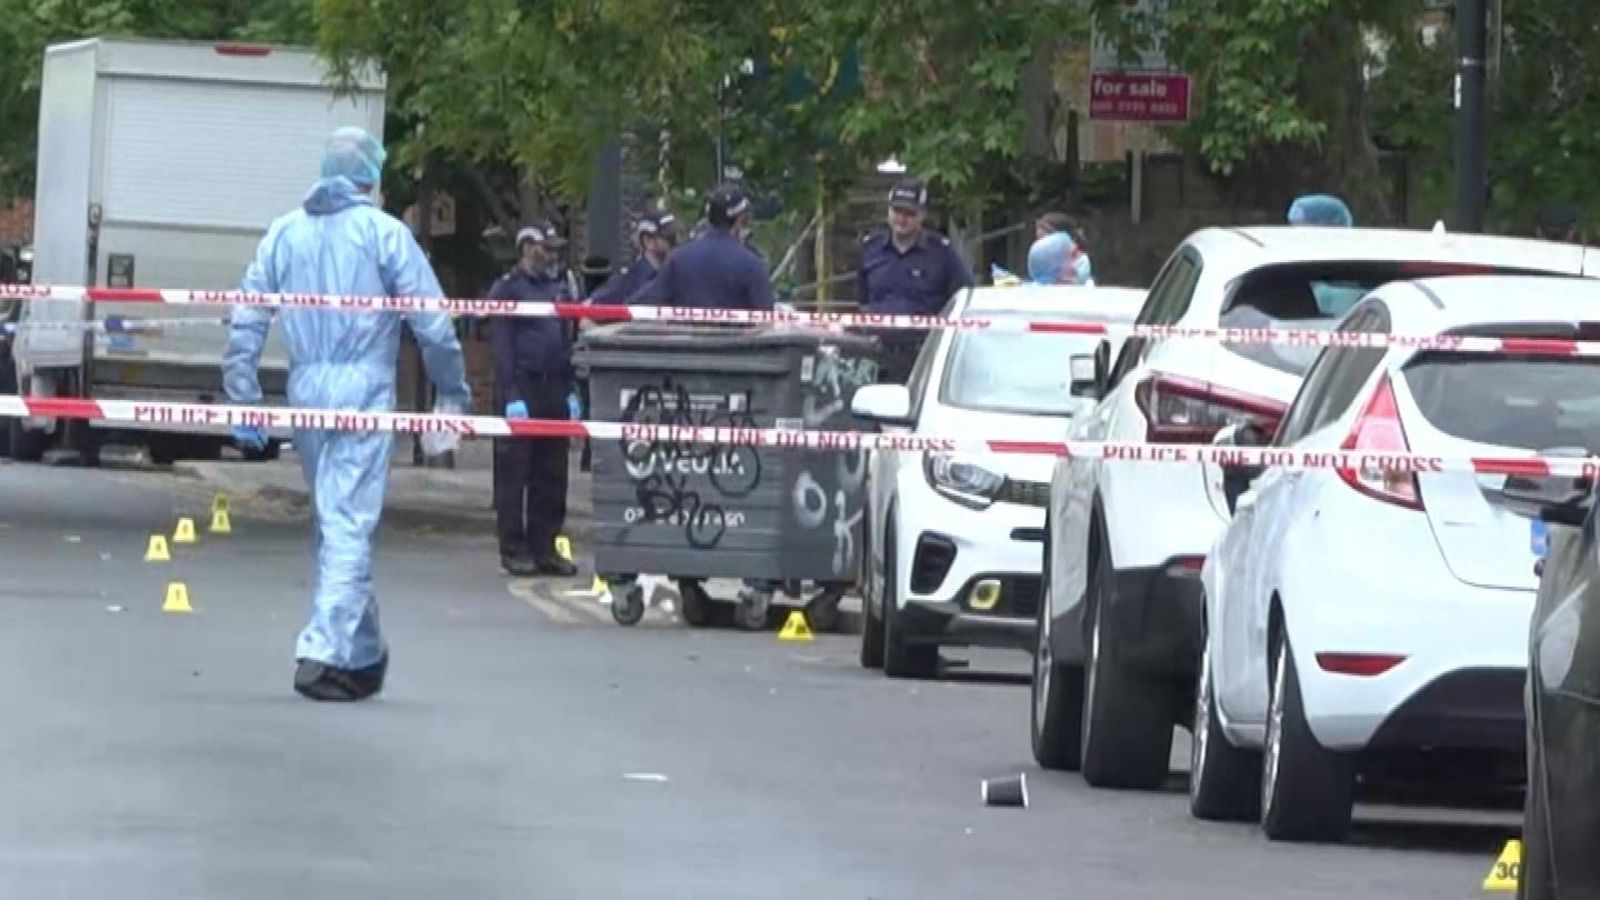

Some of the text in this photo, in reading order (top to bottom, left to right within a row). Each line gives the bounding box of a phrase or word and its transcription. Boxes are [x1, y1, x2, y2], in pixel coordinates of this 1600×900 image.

[1094, 79, 1168, 97] for sale
[134, 405, 475, 433] POLICE LINE DO NOT CROSS
[621, 424, 957, 452] POLICE LINE DO NOT CROSS
[1102, 445, 1444, 473] POLICE LINE DO NOT CROSS
